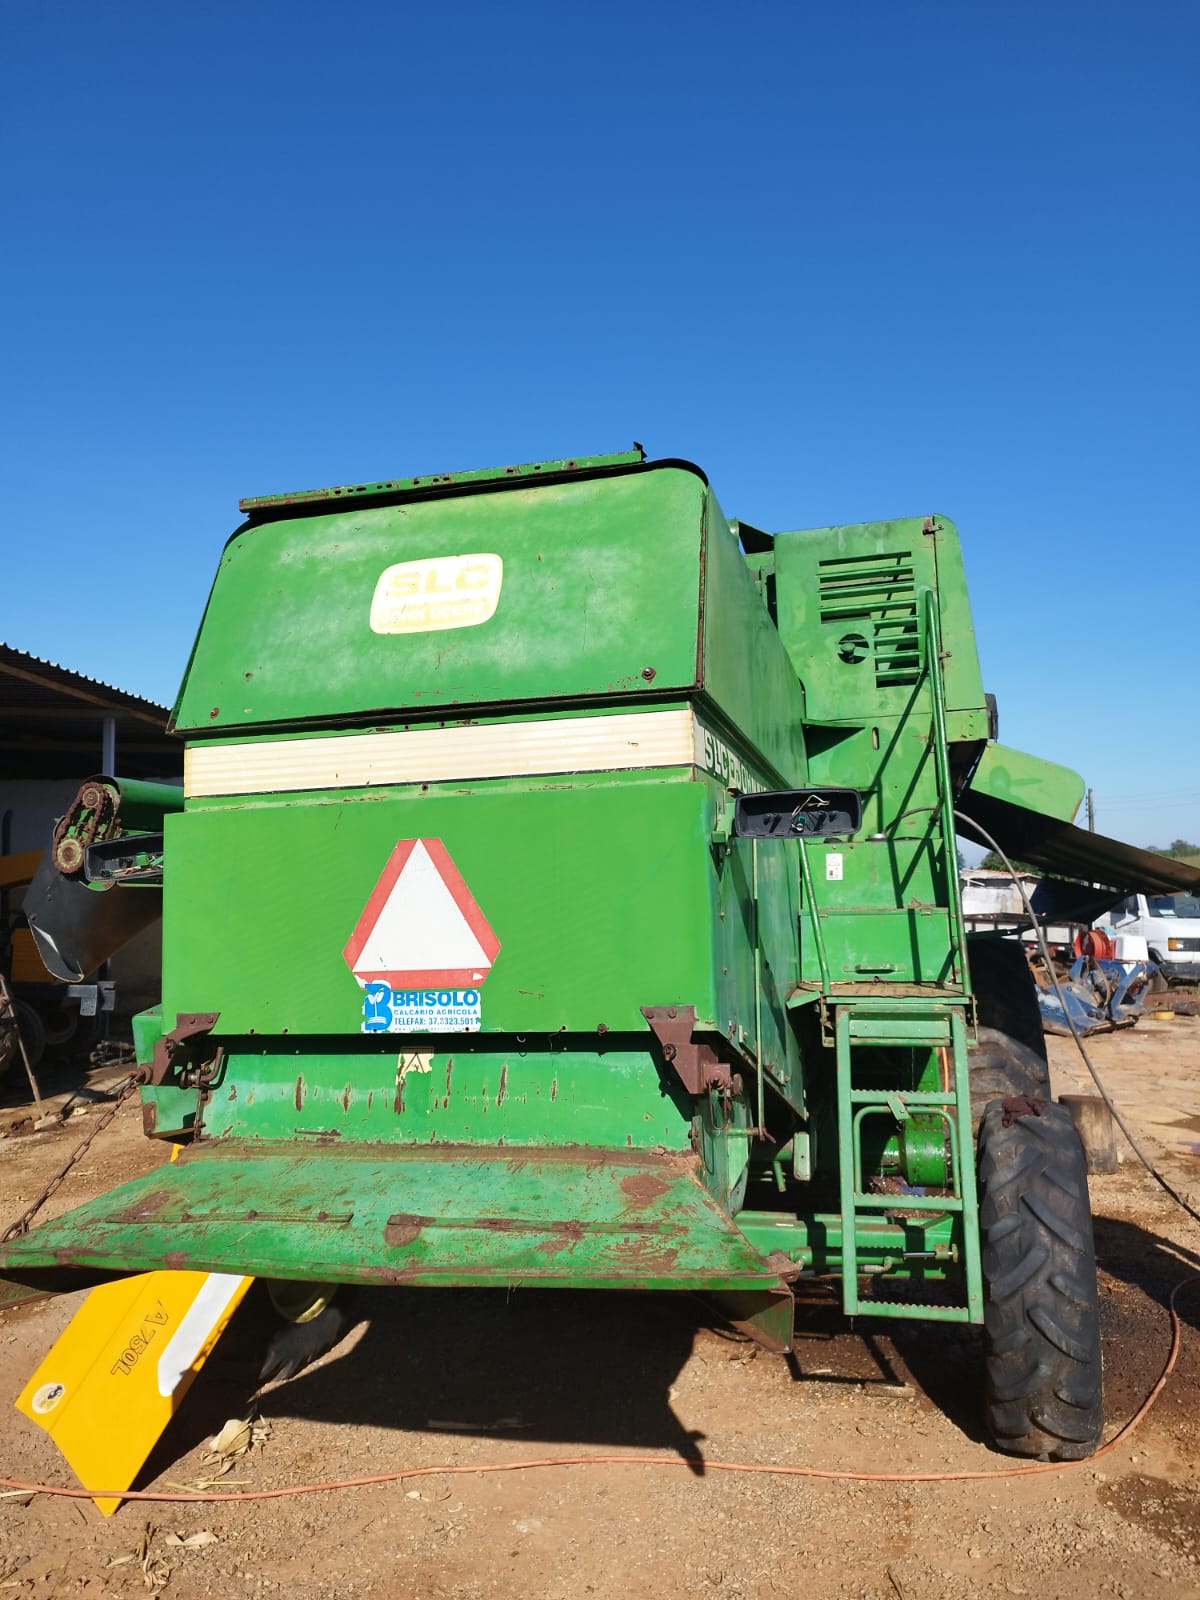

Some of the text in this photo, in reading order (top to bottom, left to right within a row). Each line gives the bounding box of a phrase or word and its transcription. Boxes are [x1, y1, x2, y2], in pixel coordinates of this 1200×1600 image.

[387, 564, 490, 597] SLC
[393, 990, 478, 1007] BRISOLO
[394, 1017, 427, 1026] TELEFAX:
